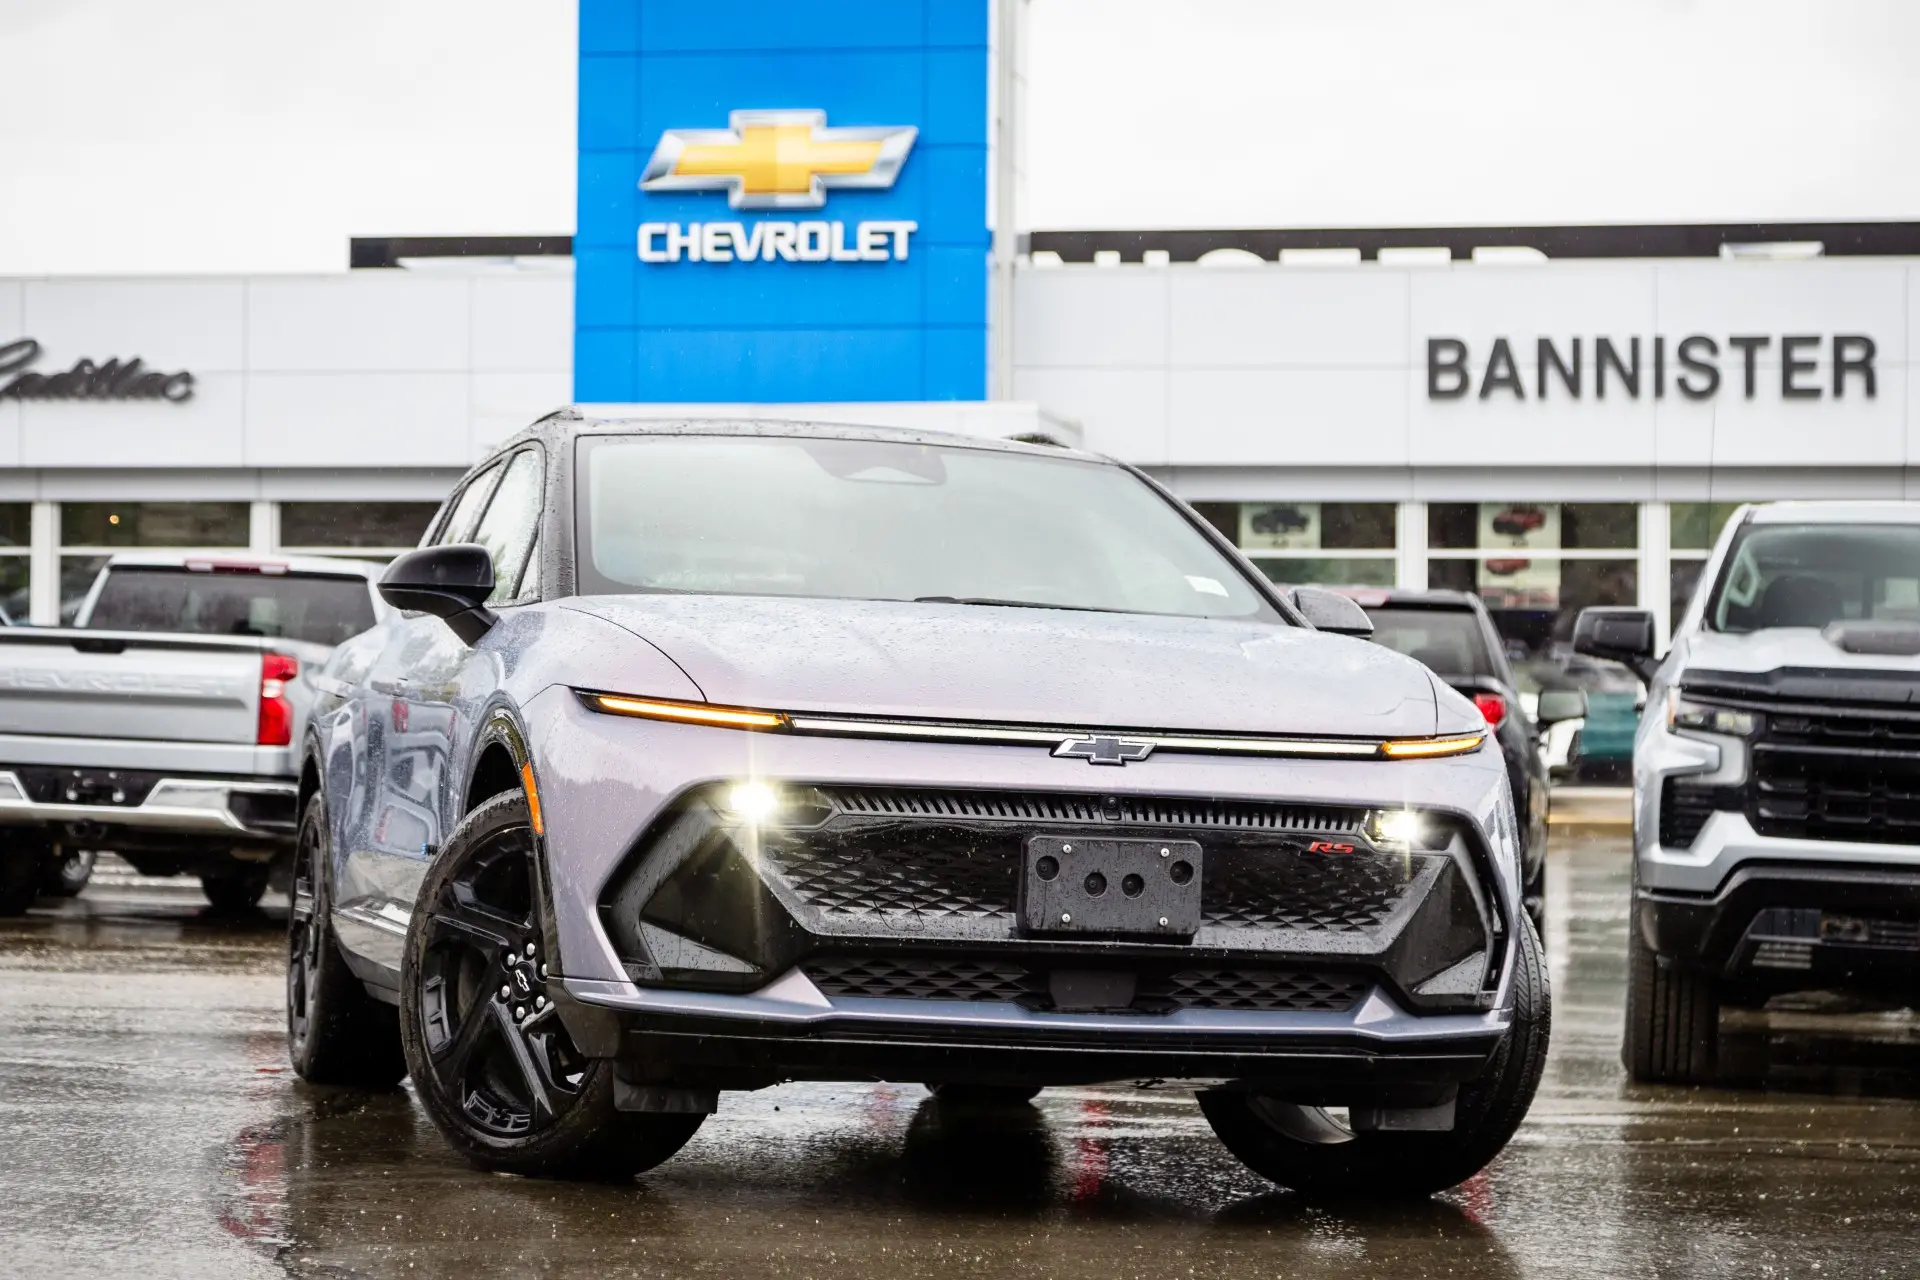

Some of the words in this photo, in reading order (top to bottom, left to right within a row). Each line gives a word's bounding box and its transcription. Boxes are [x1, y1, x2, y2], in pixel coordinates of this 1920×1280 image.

[637, 220, 918, 263] CHEVROLET
[1426, 335, 1879, 401] BANNISTER
[1308, 841, 1355, 854] RS
